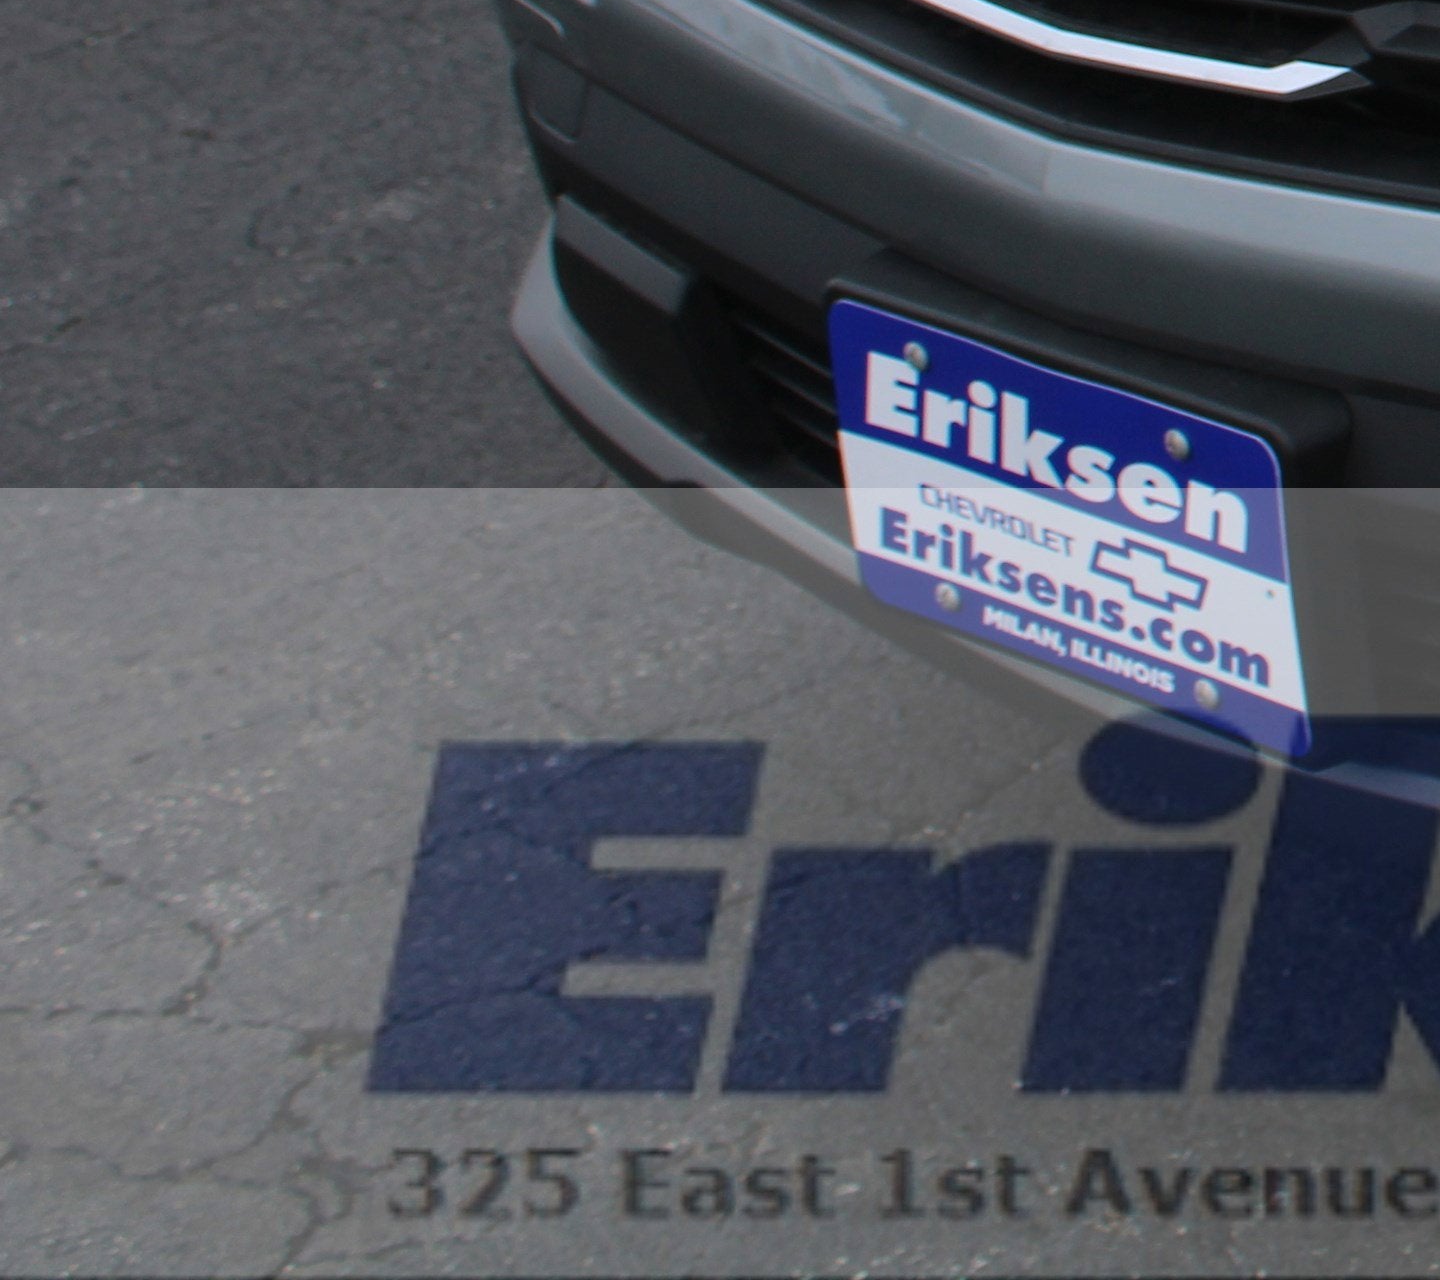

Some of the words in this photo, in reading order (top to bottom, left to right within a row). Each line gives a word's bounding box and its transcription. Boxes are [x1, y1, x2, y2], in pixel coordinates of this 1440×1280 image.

[865, 350, 1248, 553] Eriksen
[920, 483, 1075, 557] CHEVROLET
[878, 506, 1270, 687] Eriksens.com
[982, 605, 1066, 657] MILAN,
[1070, 639, 1175, 693] ILLINOIS
